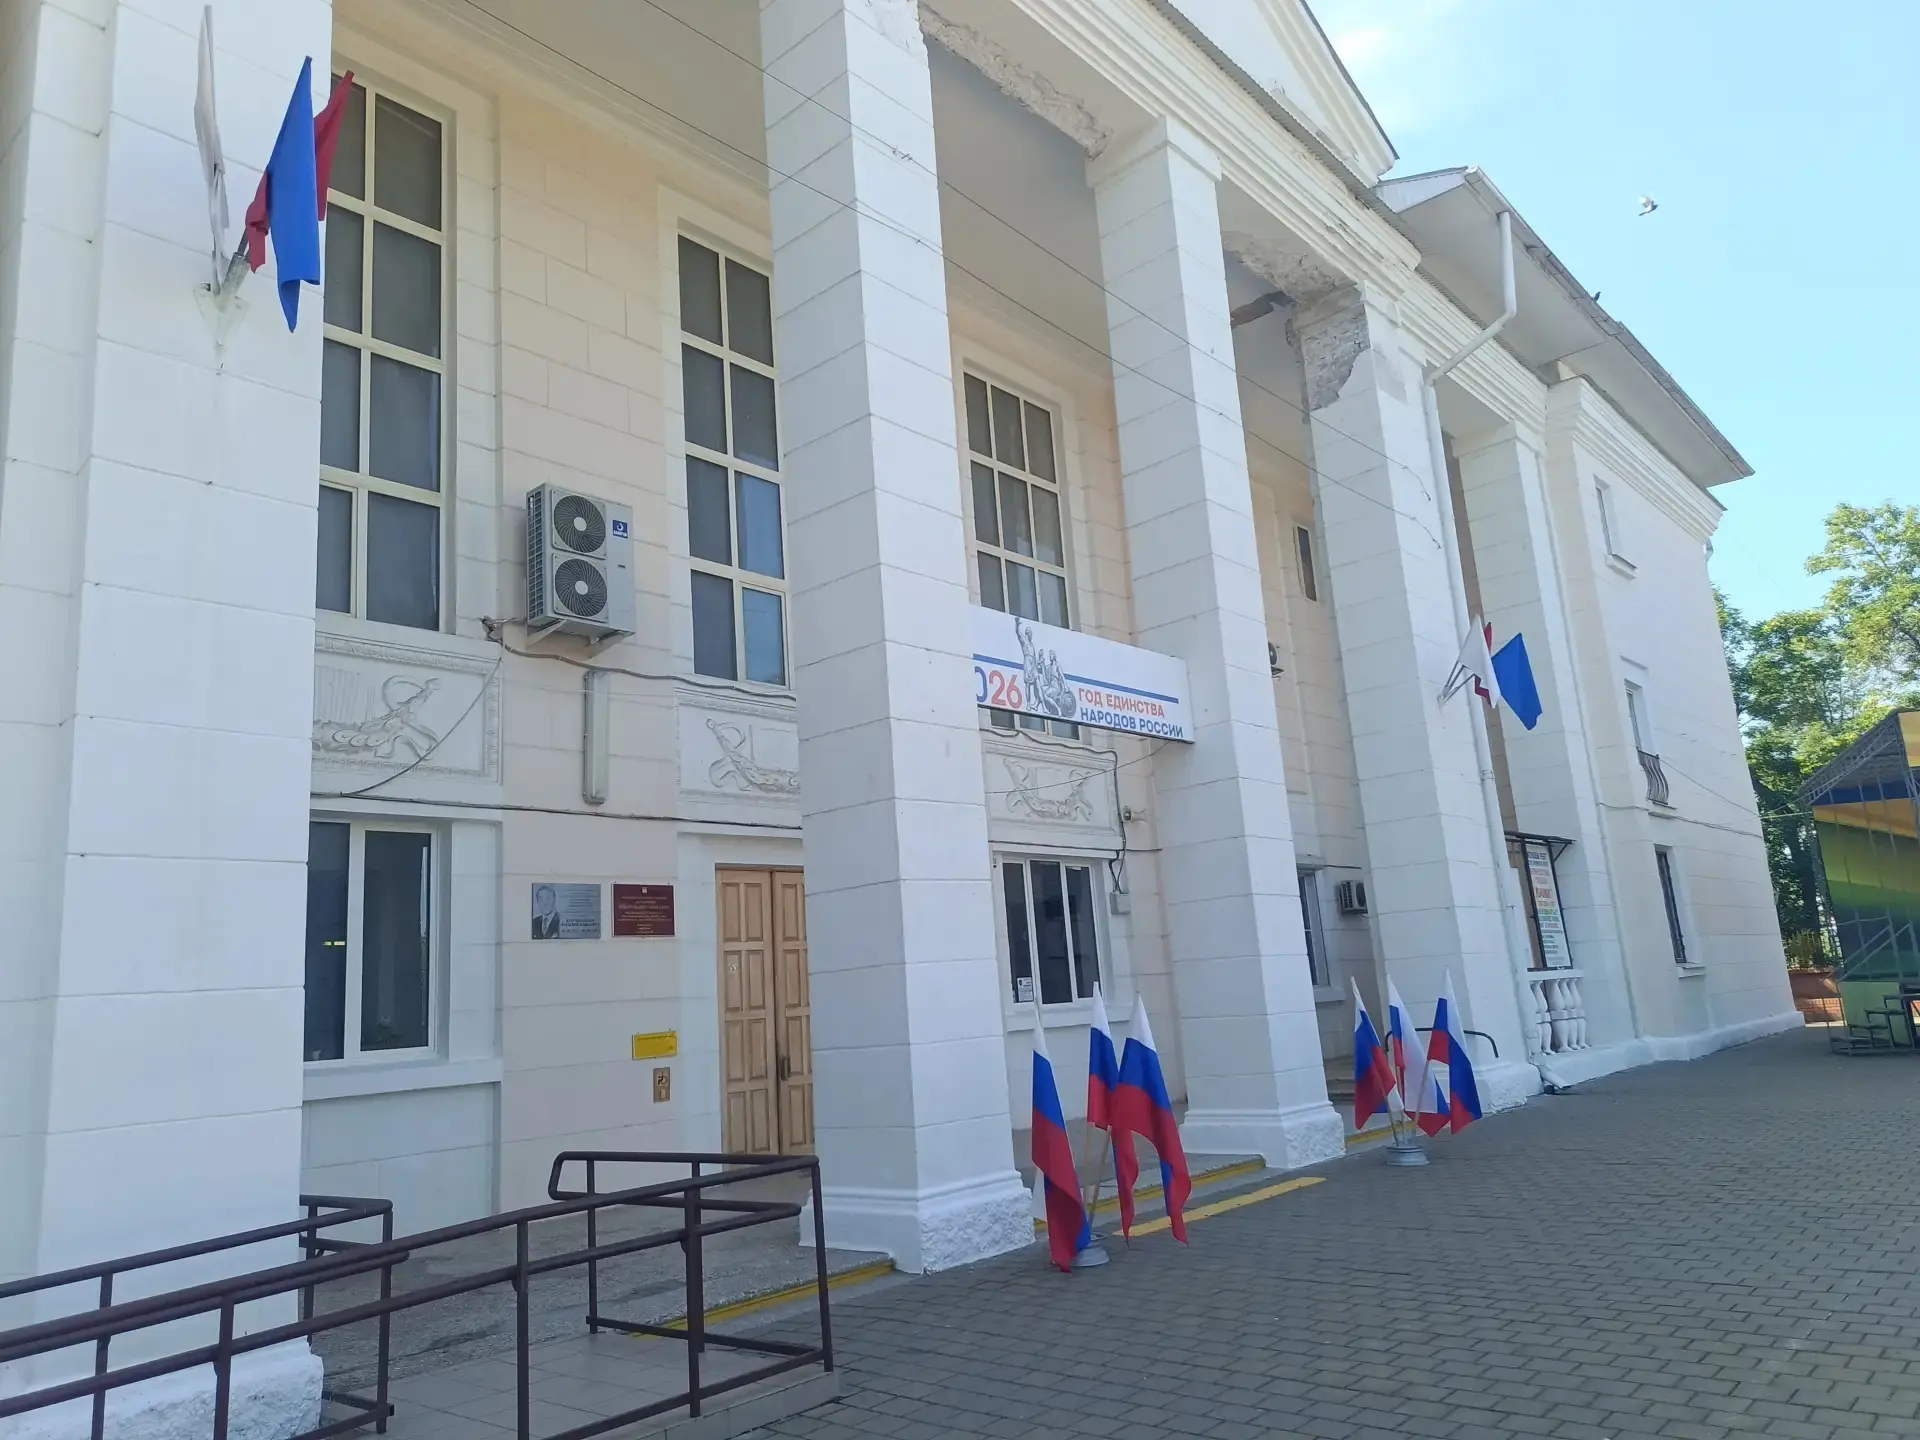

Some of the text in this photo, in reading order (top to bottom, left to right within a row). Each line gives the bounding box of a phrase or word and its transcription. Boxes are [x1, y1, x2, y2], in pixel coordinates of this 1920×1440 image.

[1078, 688, 1165, 718] ГОД ЕДИНСТВА
[1080, 707, 1183, 738] НАРОДОВ РОССИИ
